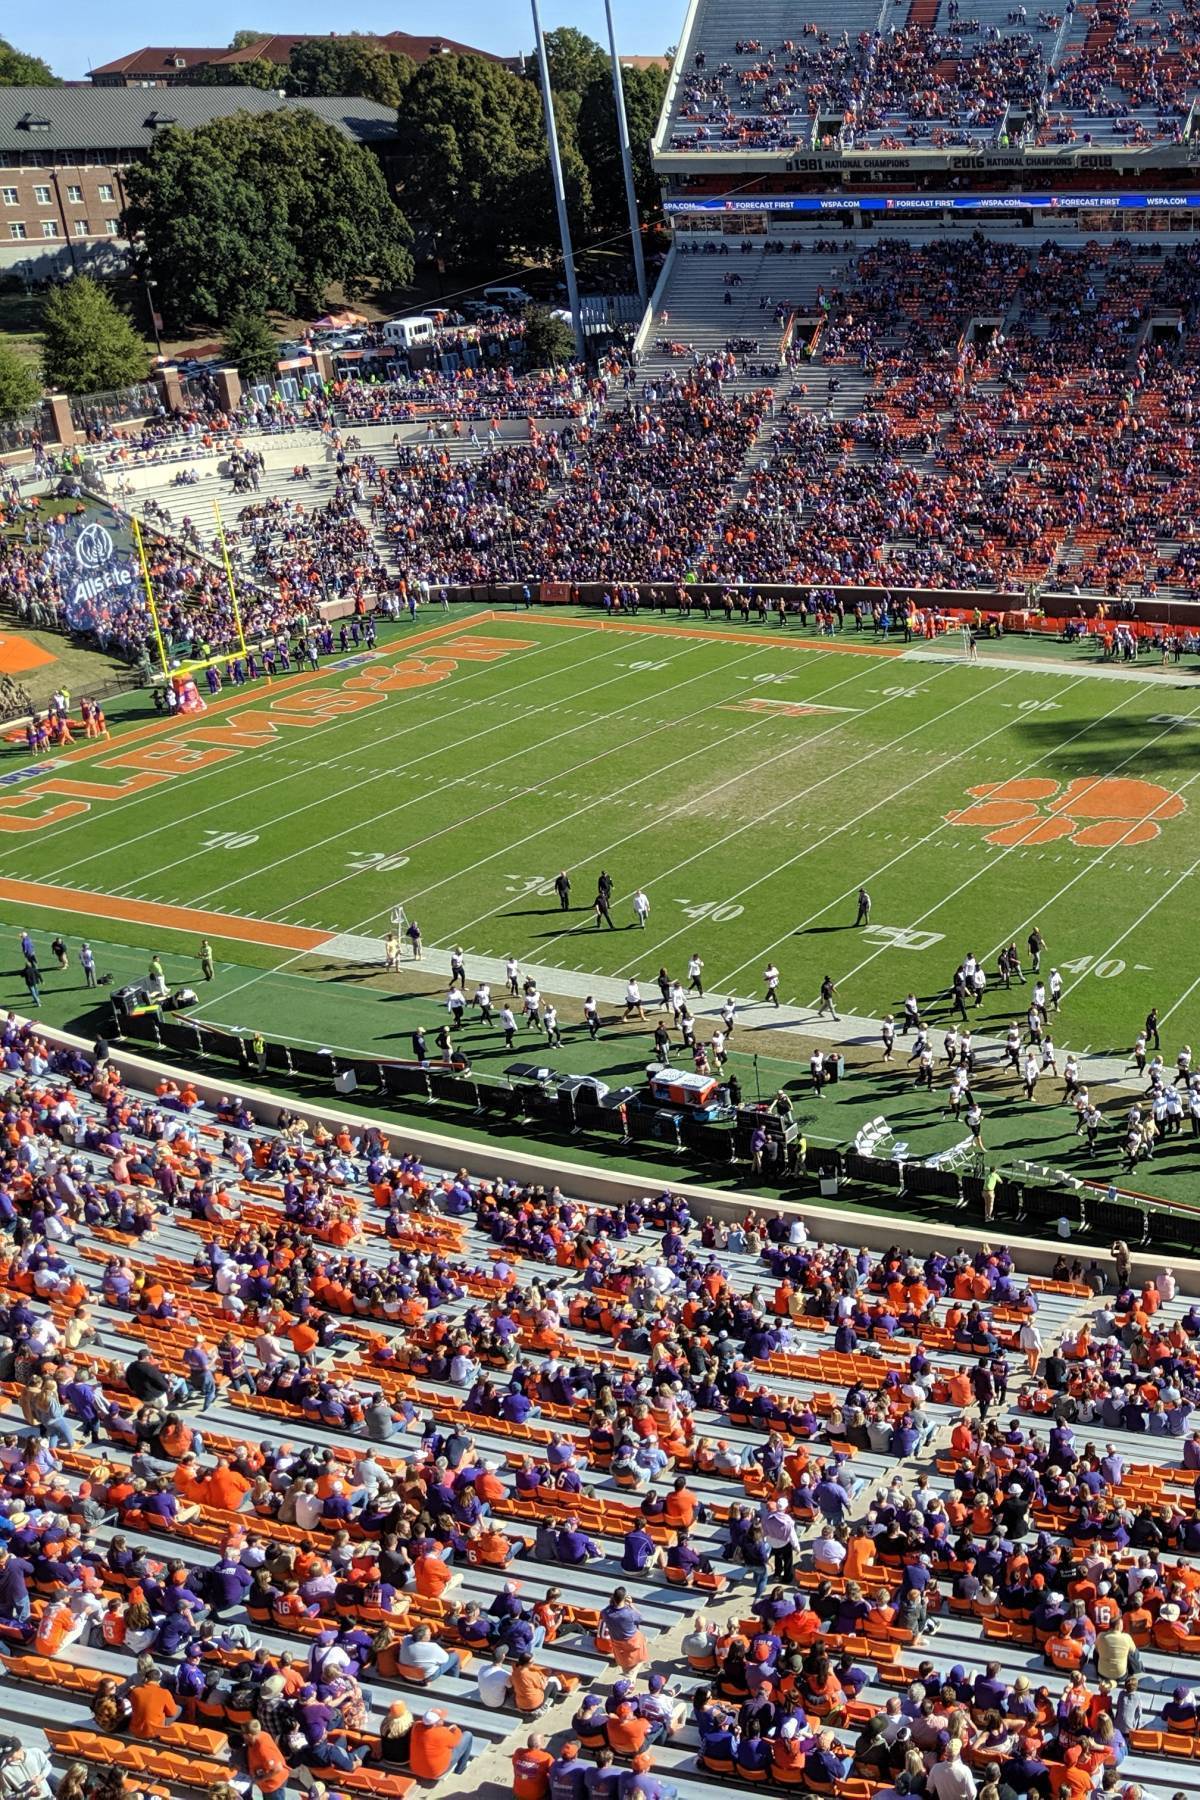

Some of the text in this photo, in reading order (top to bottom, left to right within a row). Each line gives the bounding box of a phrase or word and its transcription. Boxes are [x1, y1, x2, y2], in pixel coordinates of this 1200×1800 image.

[793, 159, 911, 171] 1981 NATIONAL CHAMPIONS
[953, 155, 1073, 170] 2016 NATIONAL CHAMPIONS
[1080, 154, 1113, 168] 2018
[735, 201, 773, 210] FORECAST
[774, 201, 795, 210] FIRST
[820, 200, 861, 209] WSPA.COM
[896, 200, 934, 208] FORECAST
[935, 200, 955, 208] FIRST
[980, 198, 1022, 207] WSPA.COM
[1060, 198, 1099, 207] FORECAST
[1100, 198, 1121, 206] FIRST
[1146, 197, 1188, 206] WSPA.COM
[751, 671, 801, 684] 20
[881, 686, 931, 699] 30
[1016, 699, 1064, 712] 40
[201, 831, 260, 850] 10
[344, 852, 410, 872] 20
[505, 875, 558, 896] 30
[681, 901, 746, 922] 40
[1059, 954, 1127, 979] 40
[556, 1472, 565, 1488] 6
[277, 1601, 290, 1615] 16
[1094, 1605, 1112, 1624] 16
